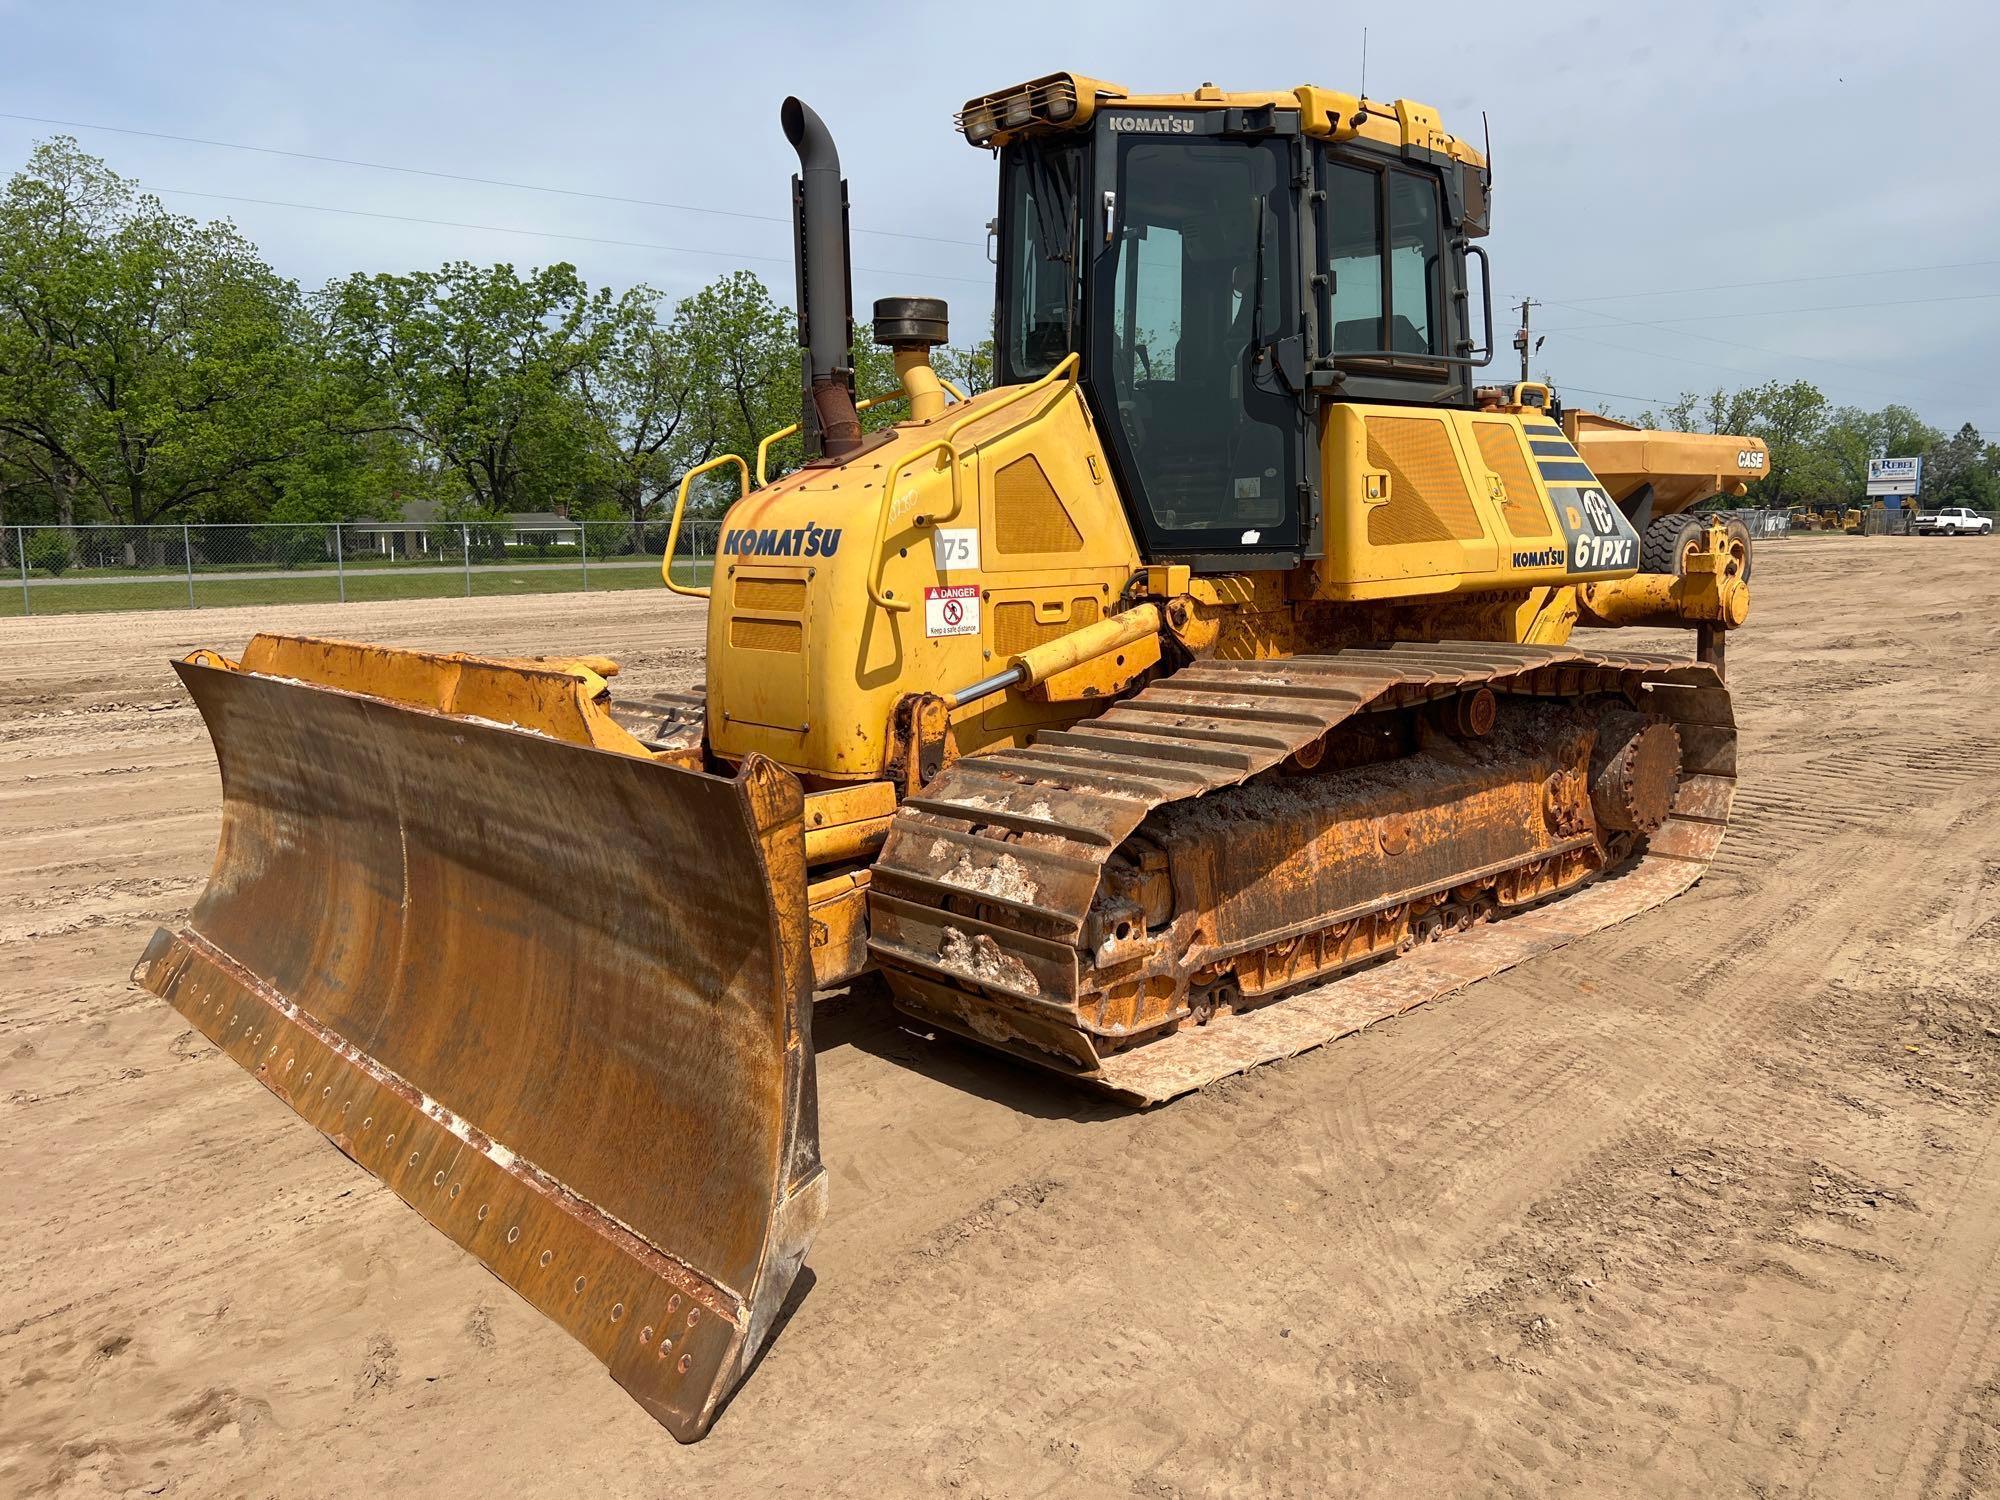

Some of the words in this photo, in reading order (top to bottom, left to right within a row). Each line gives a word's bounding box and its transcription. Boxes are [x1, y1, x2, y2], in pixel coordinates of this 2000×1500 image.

[1109, 115, 1194, 133] KOMATSU
[1738, 451, 1764, 468] CASE
[1566, 506, 1582, 530] D
[723, 521, 842, 557] KOMATSU
[943, 538, 970, 560] 75
[1512, 547, 1565, 568] KOMATSU
[1575, 534, 1632, 568] 61PXi
[941, 588, 975, 598] DANGER
[930, 627, 942, 635] Keep
